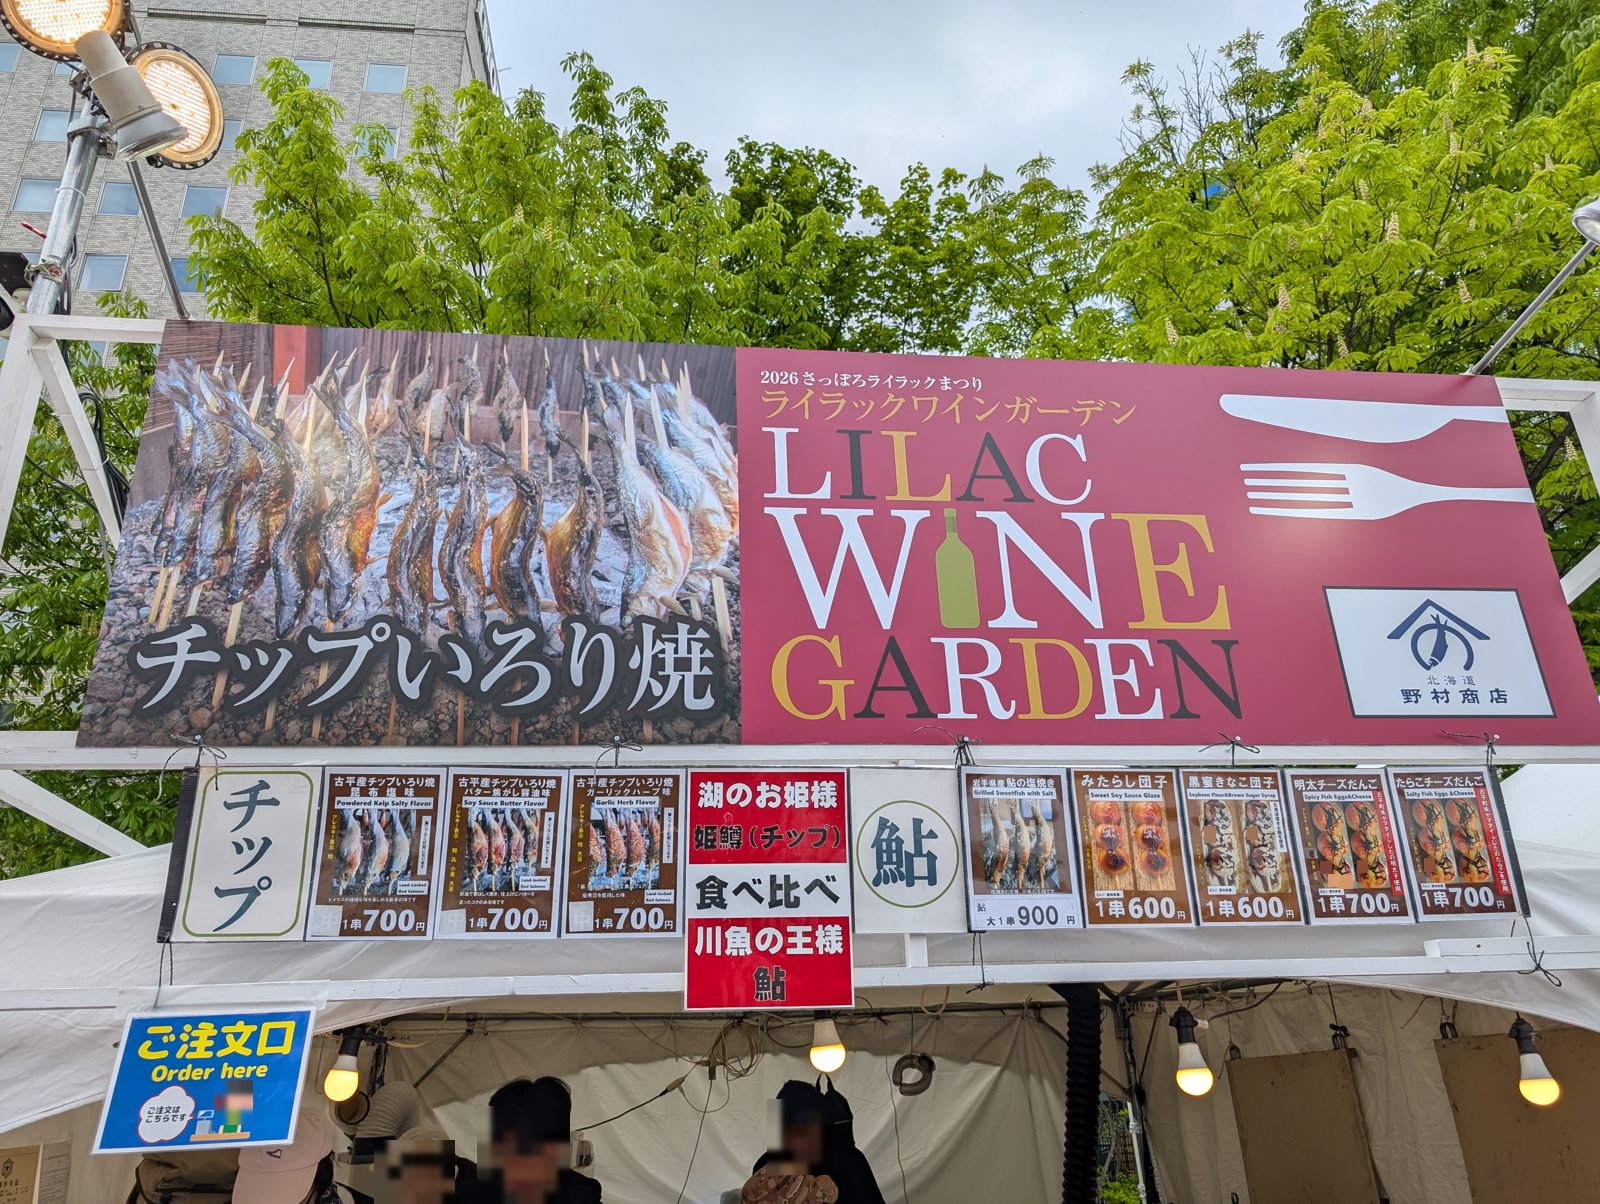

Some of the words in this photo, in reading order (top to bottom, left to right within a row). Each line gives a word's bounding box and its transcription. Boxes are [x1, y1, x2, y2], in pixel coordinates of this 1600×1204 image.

[760, 370, 799, 385] 2026
[802, 371, 983, 392] さっぽろライラックまつり
[761, 388, 1138, 427] ライラックワインガーデン
[761, 426, 1093, 506] LILAC
[135, 620, 717, 715] チップいろり焼
[771, 634, 1243, 721] GARDEN
[1426, 675, 1477, 686] 北海道
[1400, 688, 1508, 704] 野村商店
[334, 776, 435, 788] 古平産チップいろり焼
[350, 787, 415, 797] 昆布塩味
[458, 776, 557, 789] 古平産チップいろり焼
[576, 777, 674, 788] 古平産チップいろり焼
[1081, 774, 1168, 789] みたらし団子
[1188, 776, 1275, 789] 黒蜜きなこ団子
[1293, 778, 1378, 791] 明太チーズだんご
[1396, 776, 1484, 788] たらこチーズだんご
[697, 780, 838, 809] 湖のお姫様
[213, 779, 281, 932] チップ
[870, 815, 939, 888] 鮎
[695, 874, 840, 910] 食べ比べ
[1422, 886, 1505, 909] 1串700円
[1096, 896, 1186, 920] 1串600円
[1206, 896, 1294, 919] 1串600円
[1318, 893, 1400, 914] 1串700円
[694, 924, 844, 956] 川魚の王様
[753, 965, 786, 1002] 鮎
[138, 1020, 296, 1060] ご注文口
[151, 1063, 215, 1082] Order
[220, 1062, 269, 1079] here
[145, 1113, 187, 1124] こちらです
[147, 1105, 181, 1115] ご注文は
